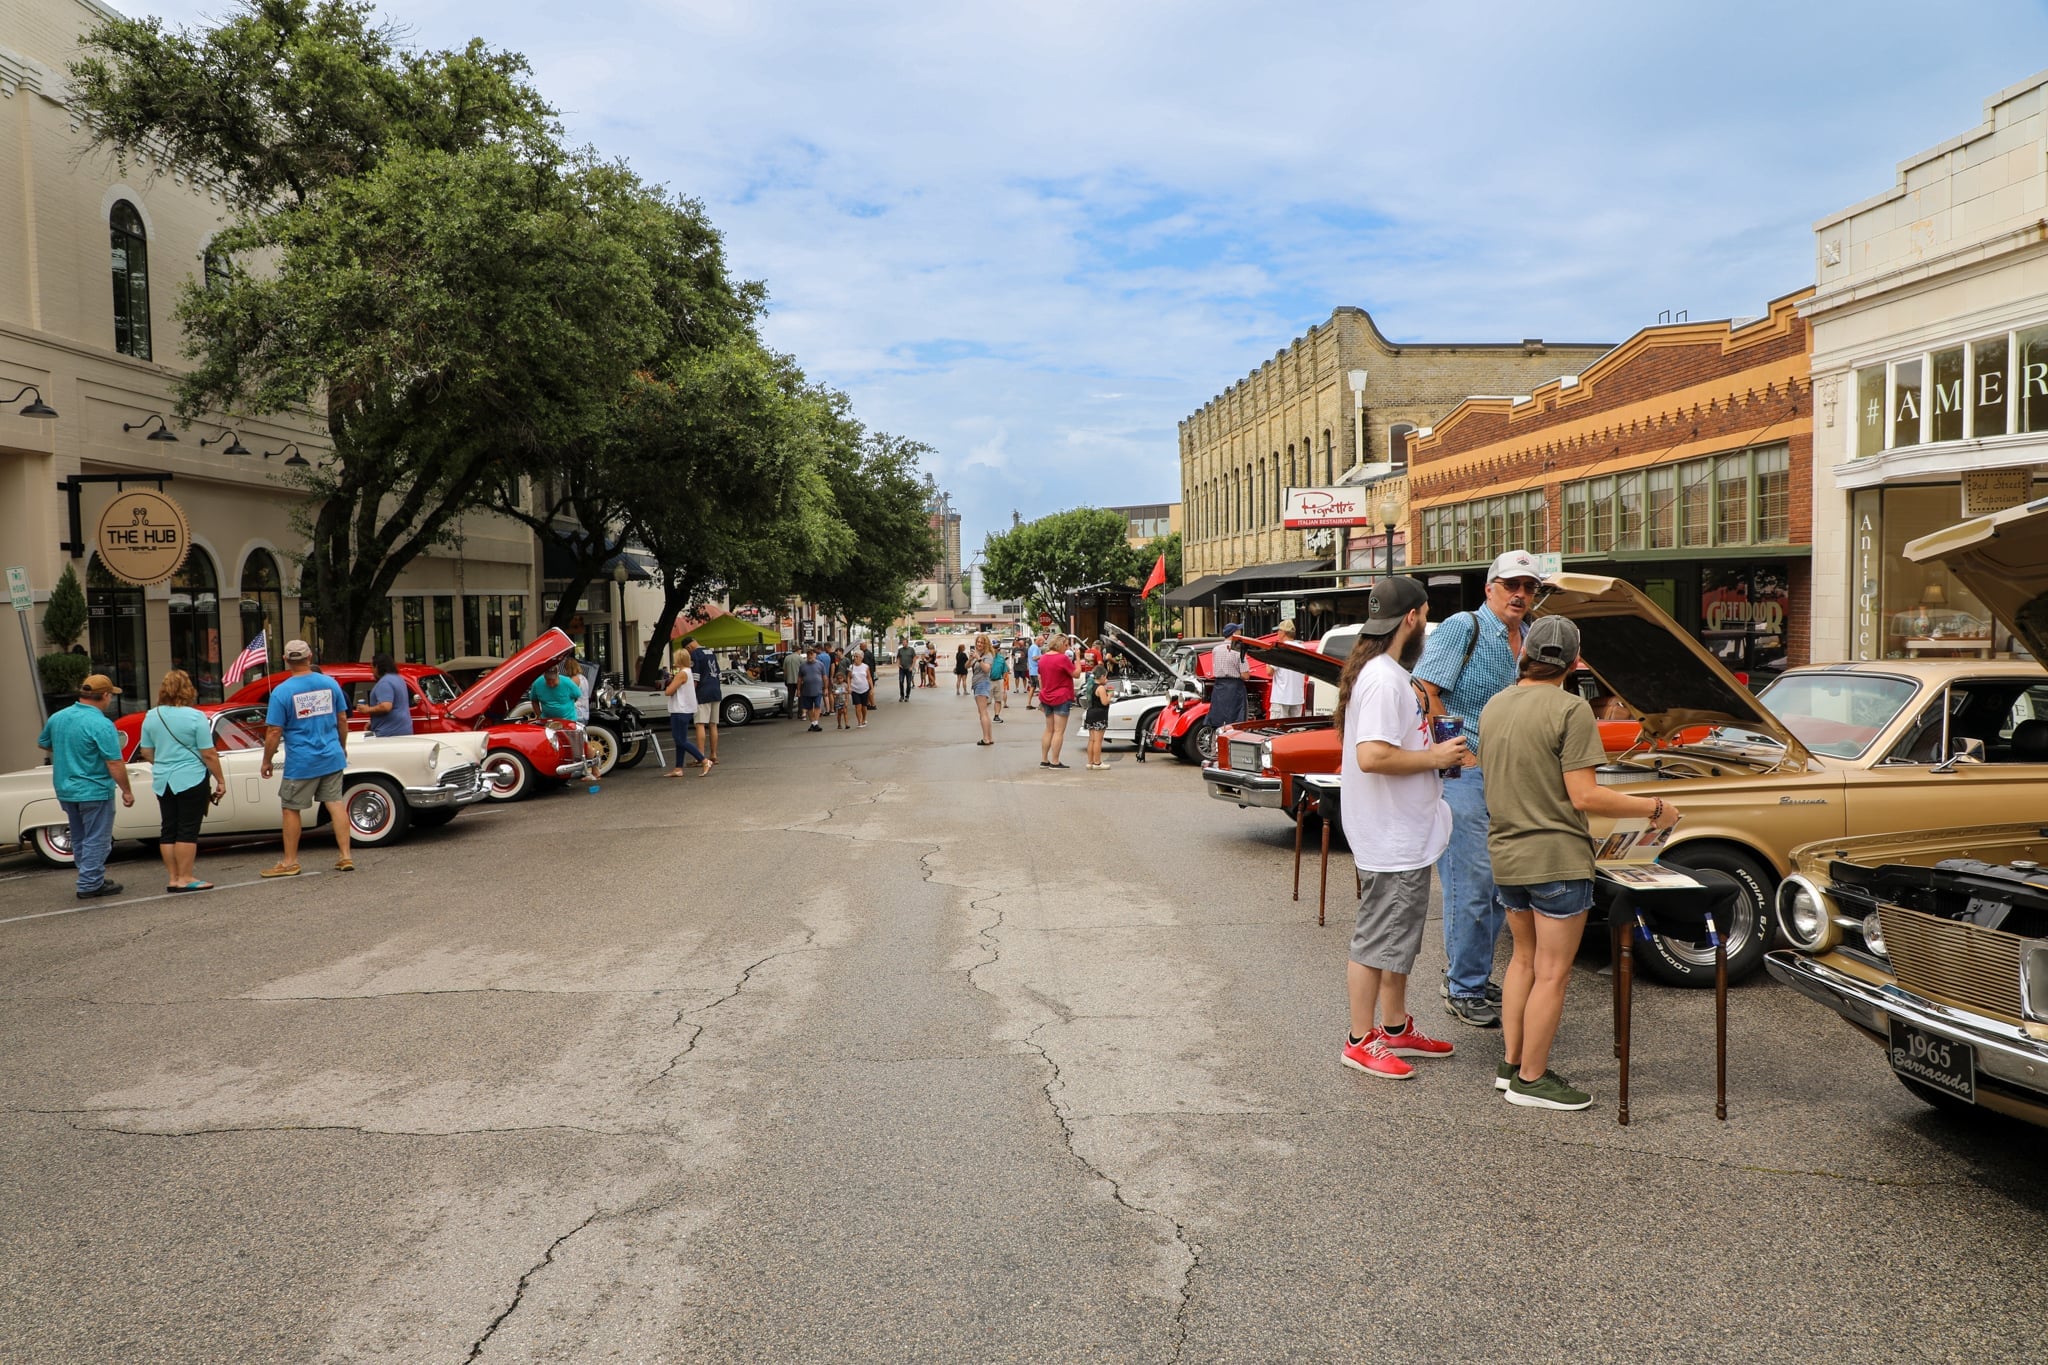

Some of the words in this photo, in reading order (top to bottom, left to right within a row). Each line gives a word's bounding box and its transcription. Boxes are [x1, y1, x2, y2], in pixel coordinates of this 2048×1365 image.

[1971, 479, 1989, 490] 2nd
[1993, 477, 2021, 490] Street
[1975, 491, 2019, 507] Emporium
[107, 530, 138, 544] THE
[144, 529, 176, 543] HUB
[12, 584, 26, 593] HOUR
[12, 596, 31, 605] PARKING
[1736, 868, 1766, 909] RADIAL
[1757, 915, 1767, 941] G/T
[1652, 934, 1691, 974] COOPER
[1906, 1033, 1951, 1068] 1965
[1893, 1047, 1971, 1094] Barracuda
